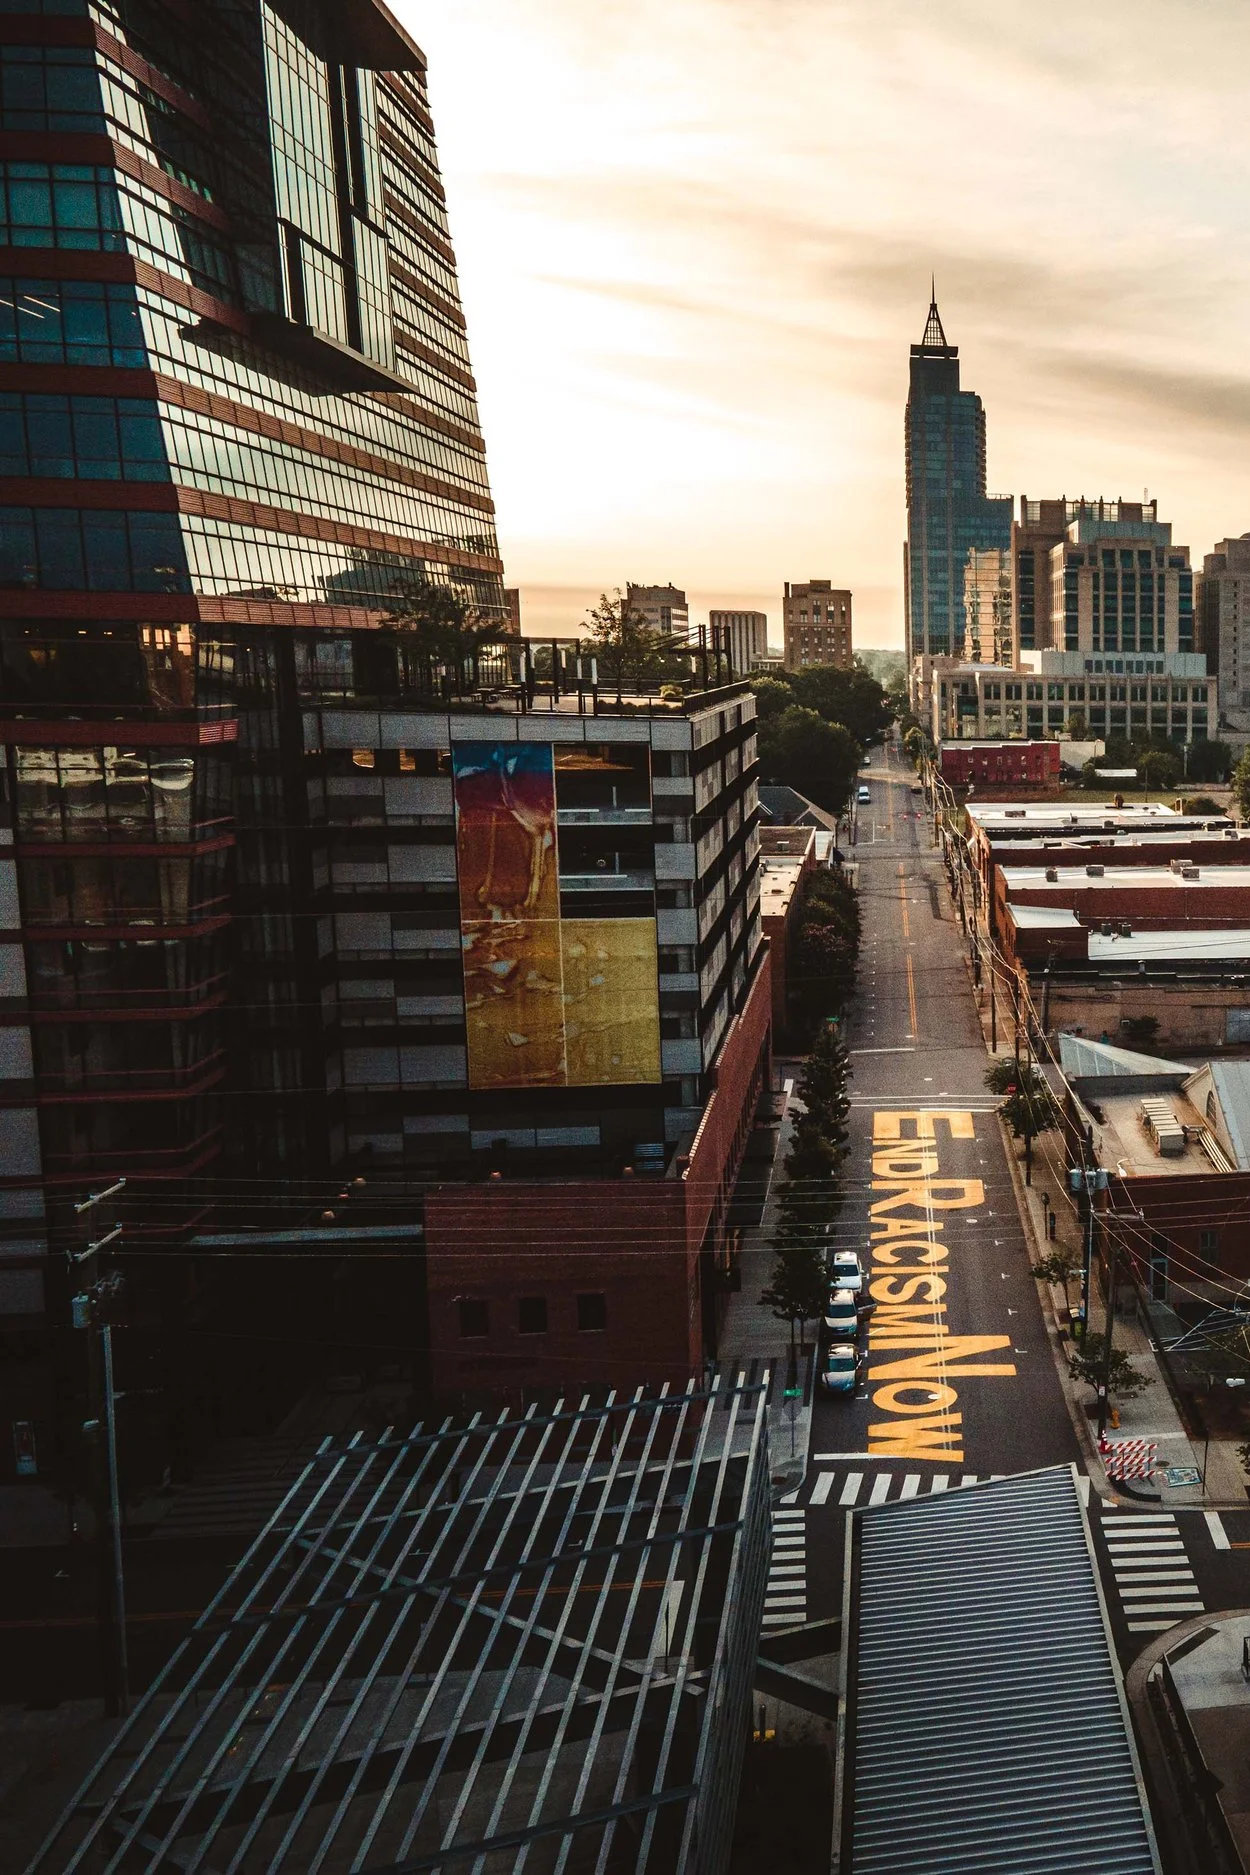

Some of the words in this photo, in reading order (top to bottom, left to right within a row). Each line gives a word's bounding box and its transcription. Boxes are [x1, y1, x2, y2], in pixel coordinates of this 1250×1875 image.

[872, 1111, 976, 1178] END
[868, 1178, 986, 1337] RACISM
[867, 1334, 1017, 1463] NOW
